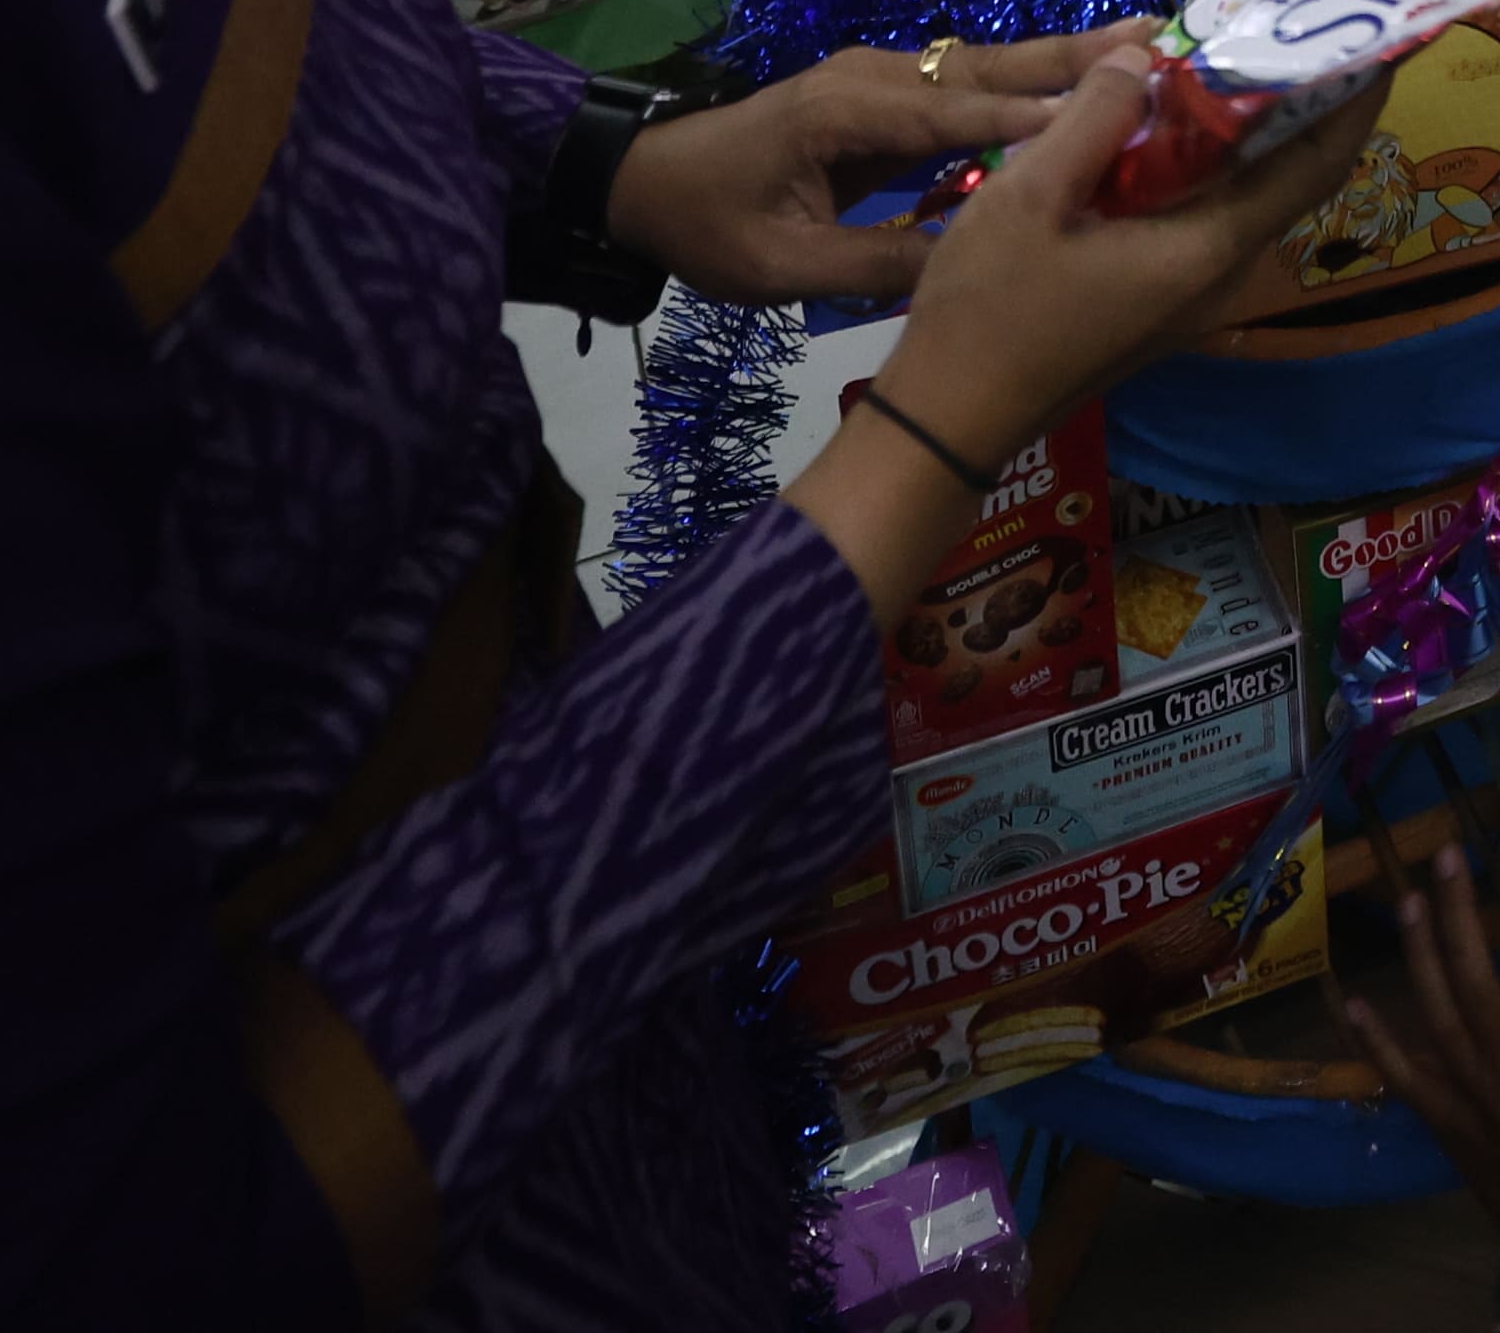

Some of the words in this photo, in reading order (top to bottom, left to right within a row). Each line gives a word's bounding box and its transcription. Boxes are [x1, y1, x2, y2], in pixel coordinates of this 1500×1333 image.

[974, 515, 1026, 551] mini
[1321, 509, 1427, 578] Good
[946, 565, 1001, 598] DOUBLE
[1002, 542, 1042, 570] CHOC
[1009, 666, 1052, 695] SCAN
[1060, 711, 1156, 760] Cream
[1164, 660, 1288, 726] Crackers
[1182, 725, 1222, 746] Krim
[1101, 756, 1174, 790] PREMIUM
[1179, 732, 1244, 764] QUALITY
[924, 778, 970, 800] Monde
